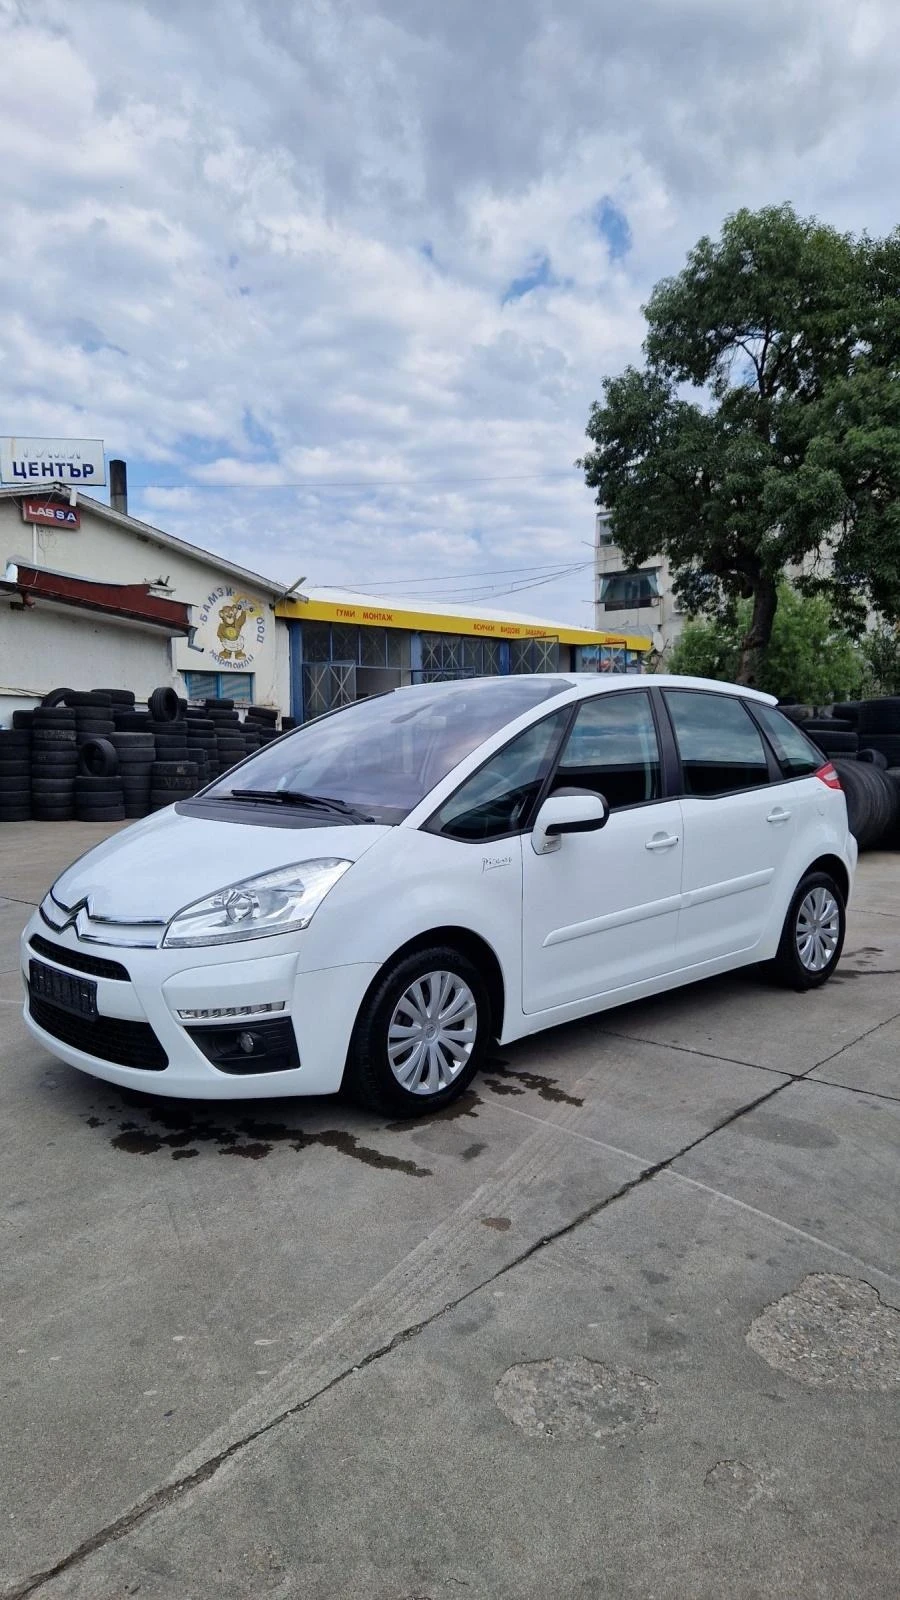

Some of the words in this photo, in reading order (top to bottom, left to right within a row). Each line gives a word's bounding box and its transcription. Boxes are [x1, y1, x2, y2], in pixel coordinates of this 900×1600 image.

[12, 461, 95, 479] ЦЕНТЪР
[28, 505, 77, 523] LASSA
[336, 608, 356, 618] ГУМИ
[362, 611, 393, 621] МОНТАЖ
